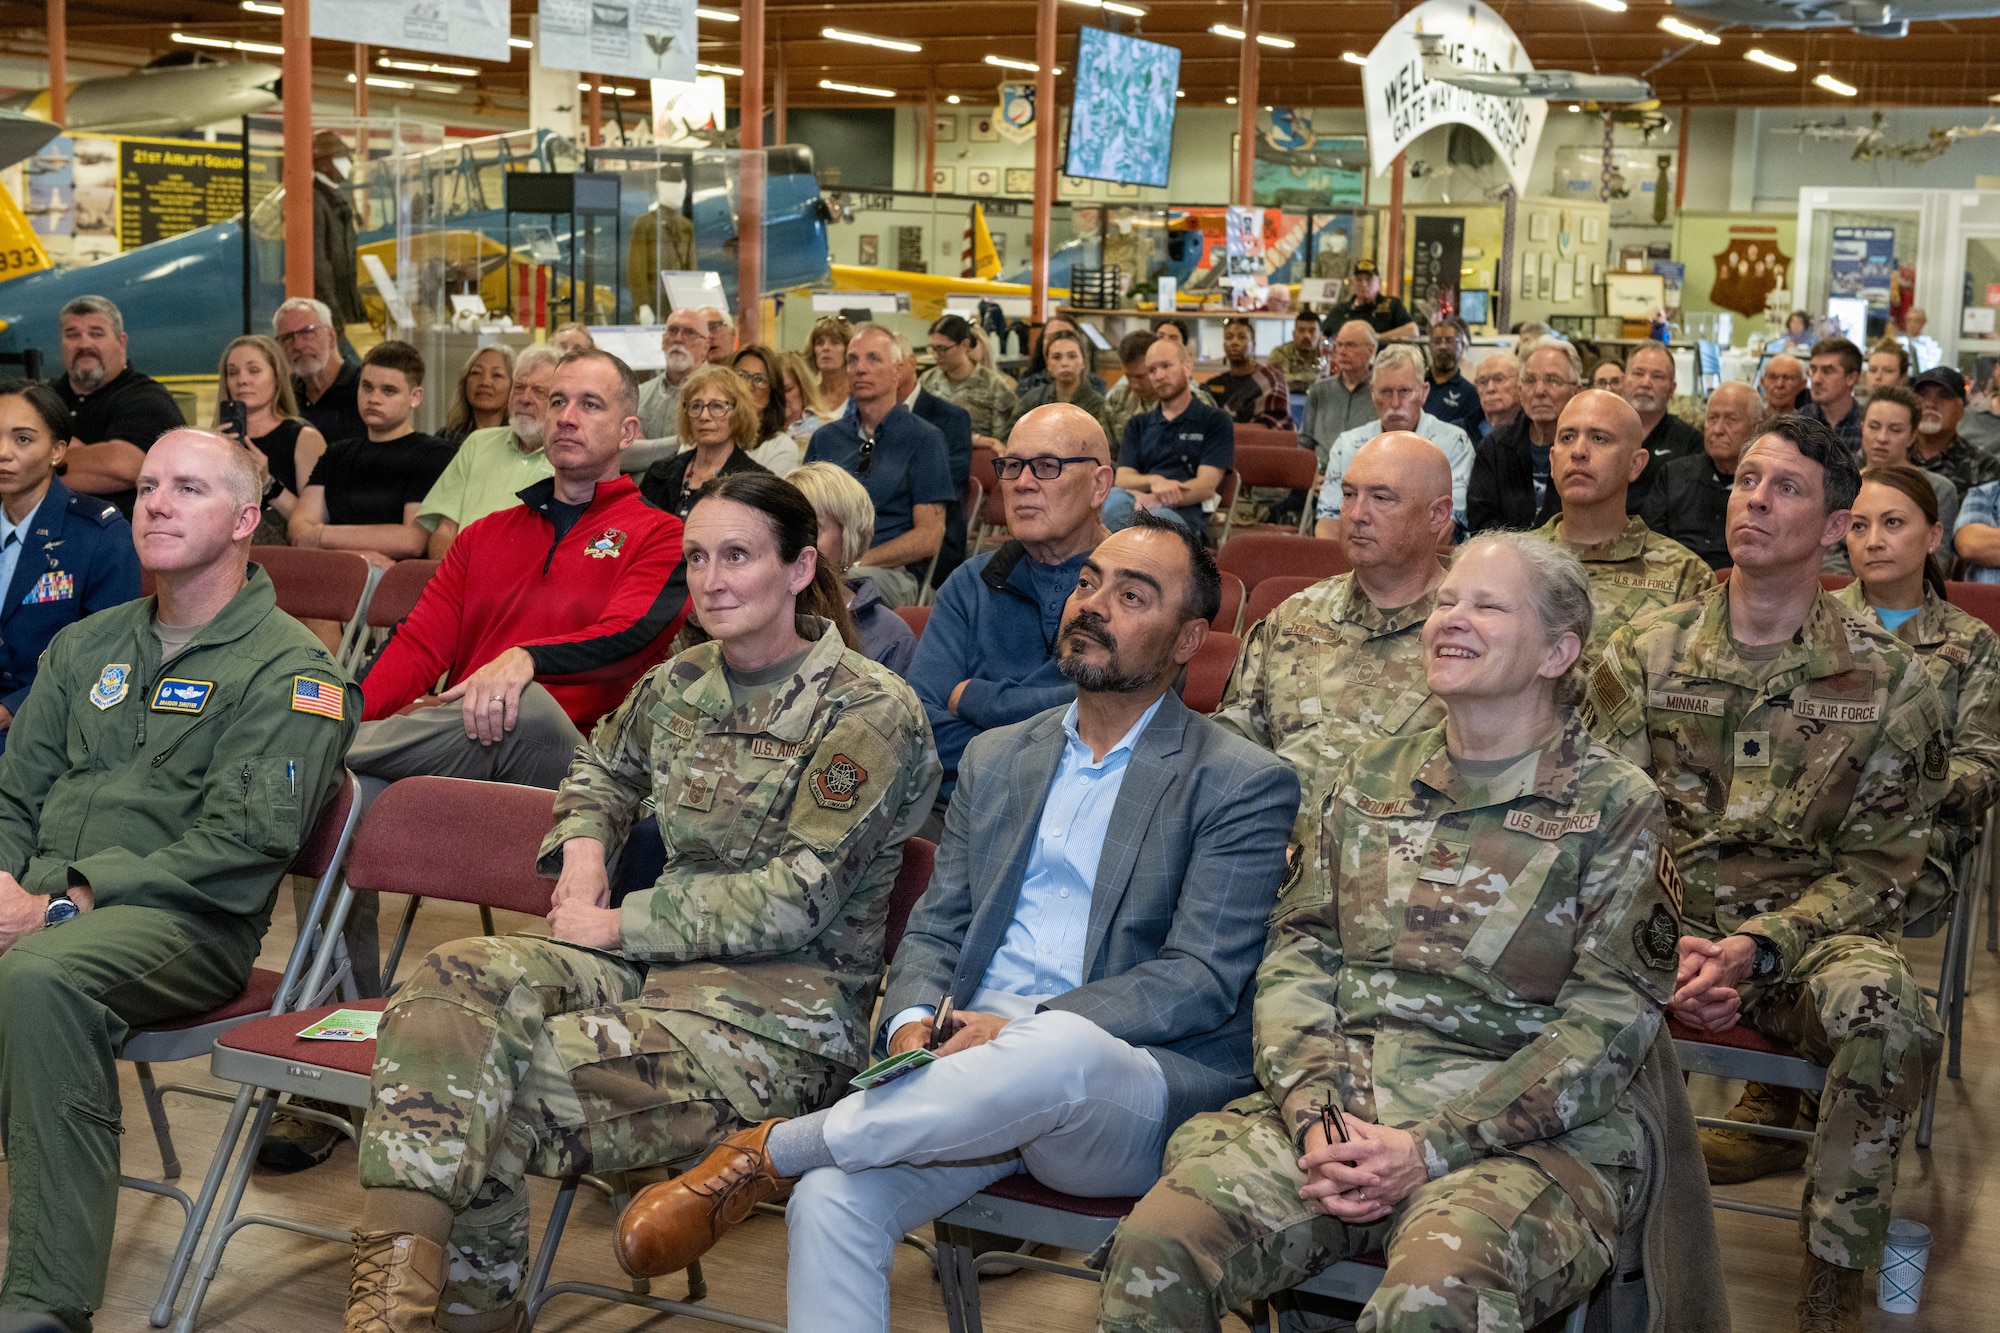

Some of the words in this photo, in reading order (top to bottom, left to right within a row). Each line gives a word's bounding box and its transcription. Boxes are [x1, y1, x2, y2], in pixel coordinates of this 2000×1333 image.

[1392, 95, 1426, 142] GATE
[1429, 86, 1452, 114] WAY
[1488, 102, 1520, 166] PACIFIC
[1614, 574, 1629, 586] U.S.
[1632, 578, 1646, 587] AIR
[1647, 580, 1675, 591] FORCE
[1666, 695, 1709, 713] MINNAR
[1798, 702, 1815, 718] U.S.
[1819, 704, 1838, 720] AIR
[1840, 705, 1876, 721] FORCE
[753, 740, 774, 756] U.S.
[777, 742, 797, 758] AIR
[826, 800, 849, 809] COMMAND
[1356, 795, 1407, 815] BODWELL
[1510, 812, 1532, 830] U.S.
[1535, 821, 1558, 836] AIR
